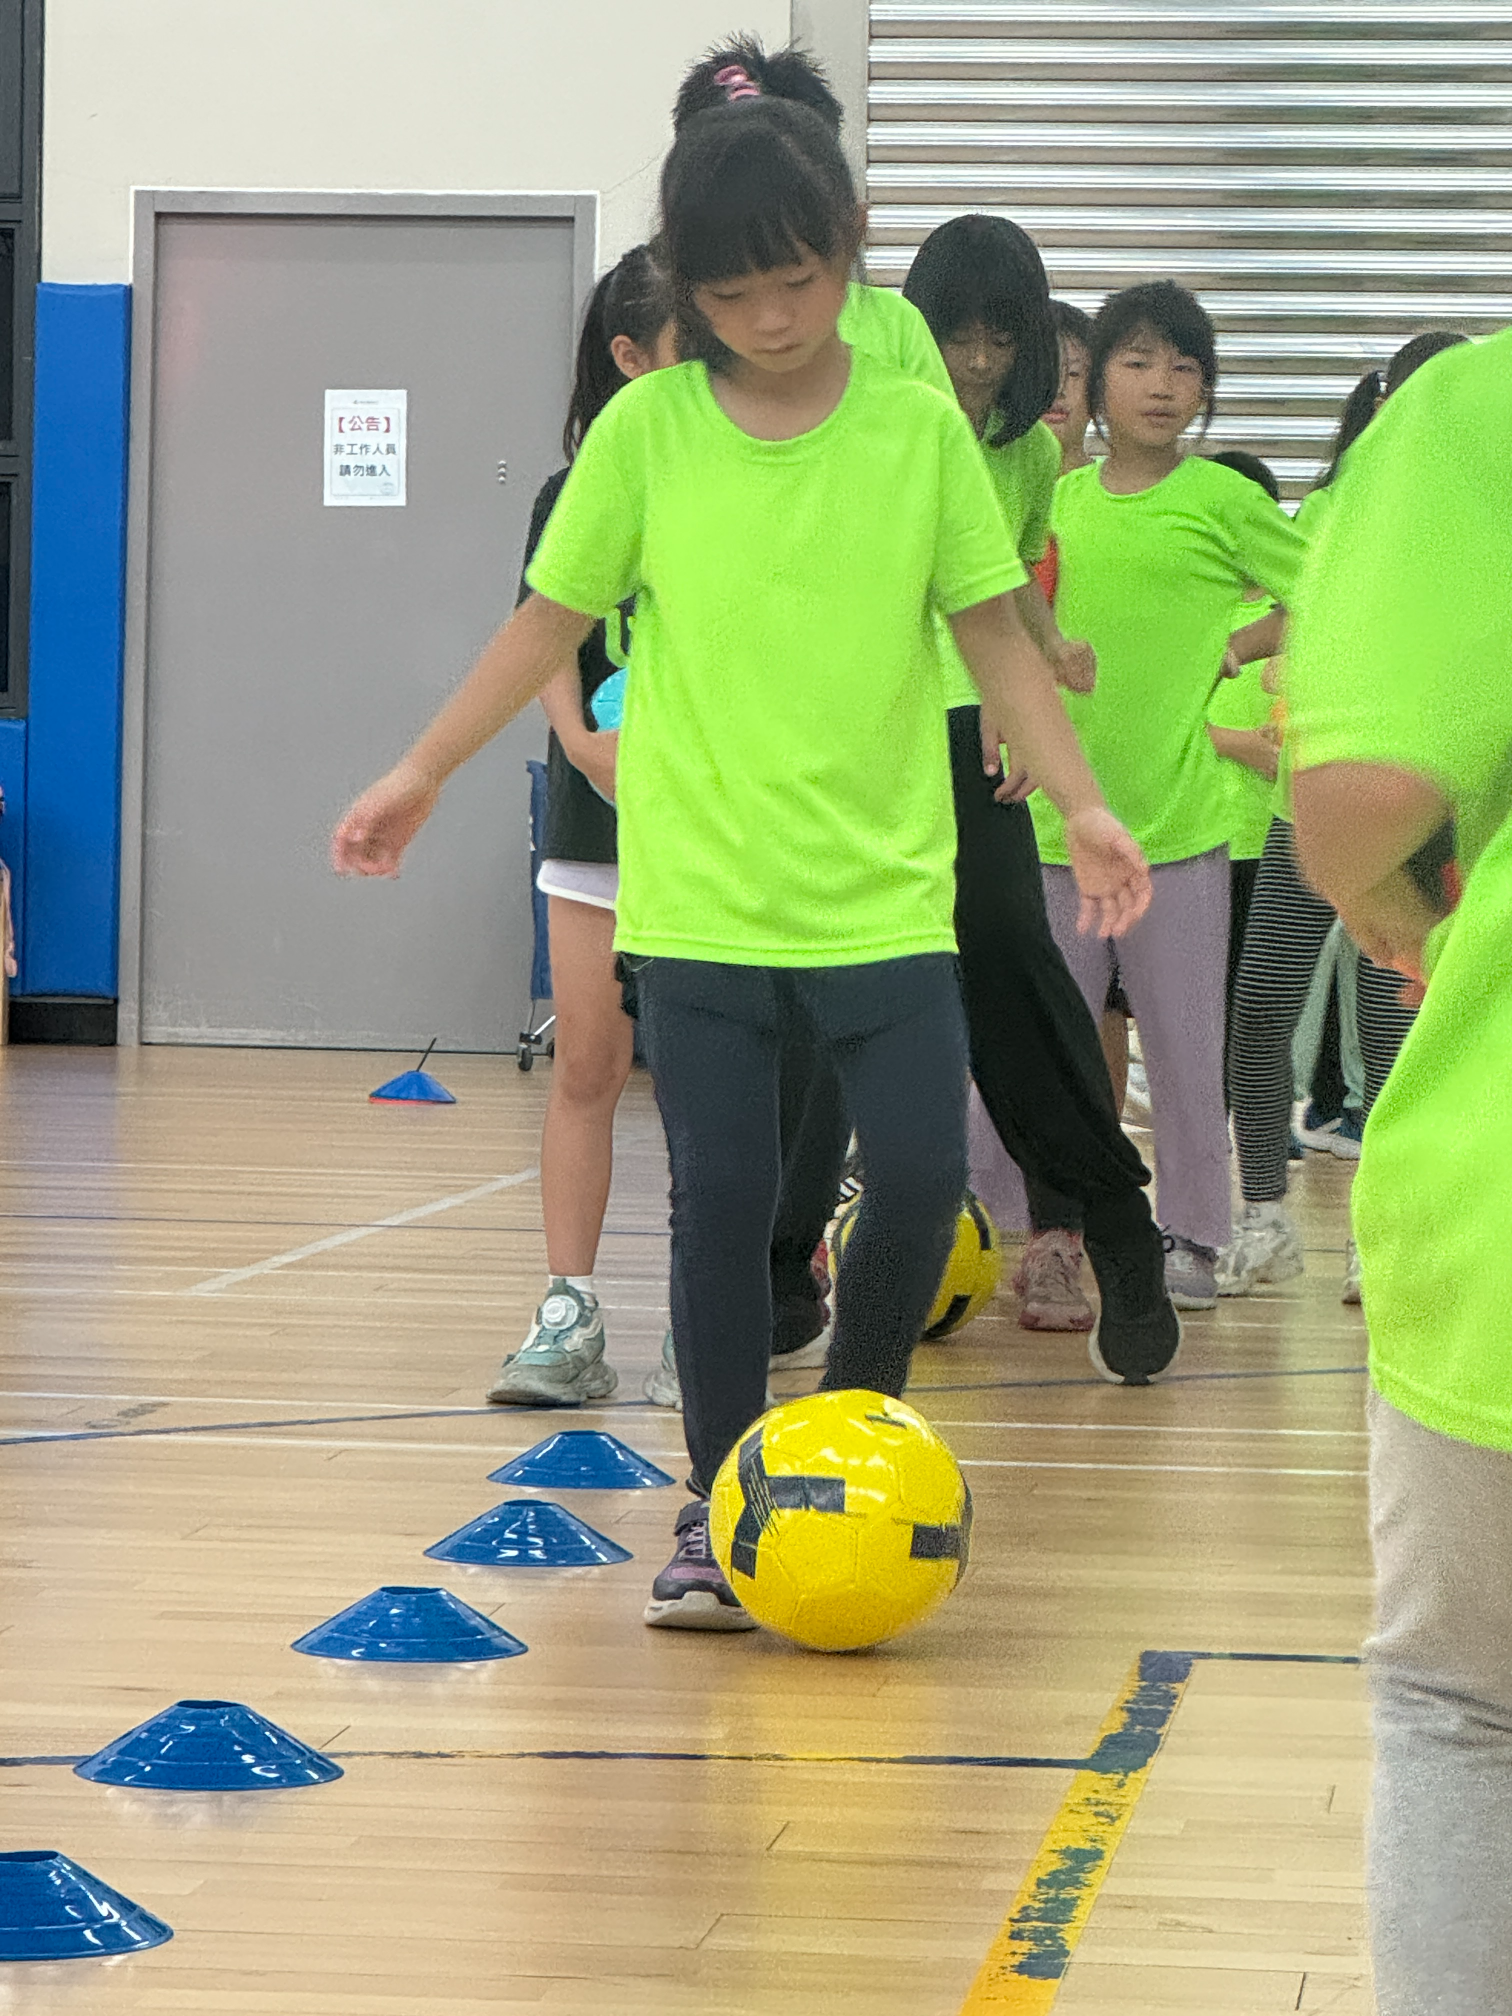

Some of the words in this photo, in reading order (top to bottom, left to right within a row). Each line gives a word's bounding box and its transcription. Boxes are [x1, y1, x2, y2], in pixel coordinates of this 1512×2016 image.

[338, 415, 391, 433] 【公告】
[333, 443, 397, 455] 非工作人員
[339, 464, 391, 477] 請勿進入
